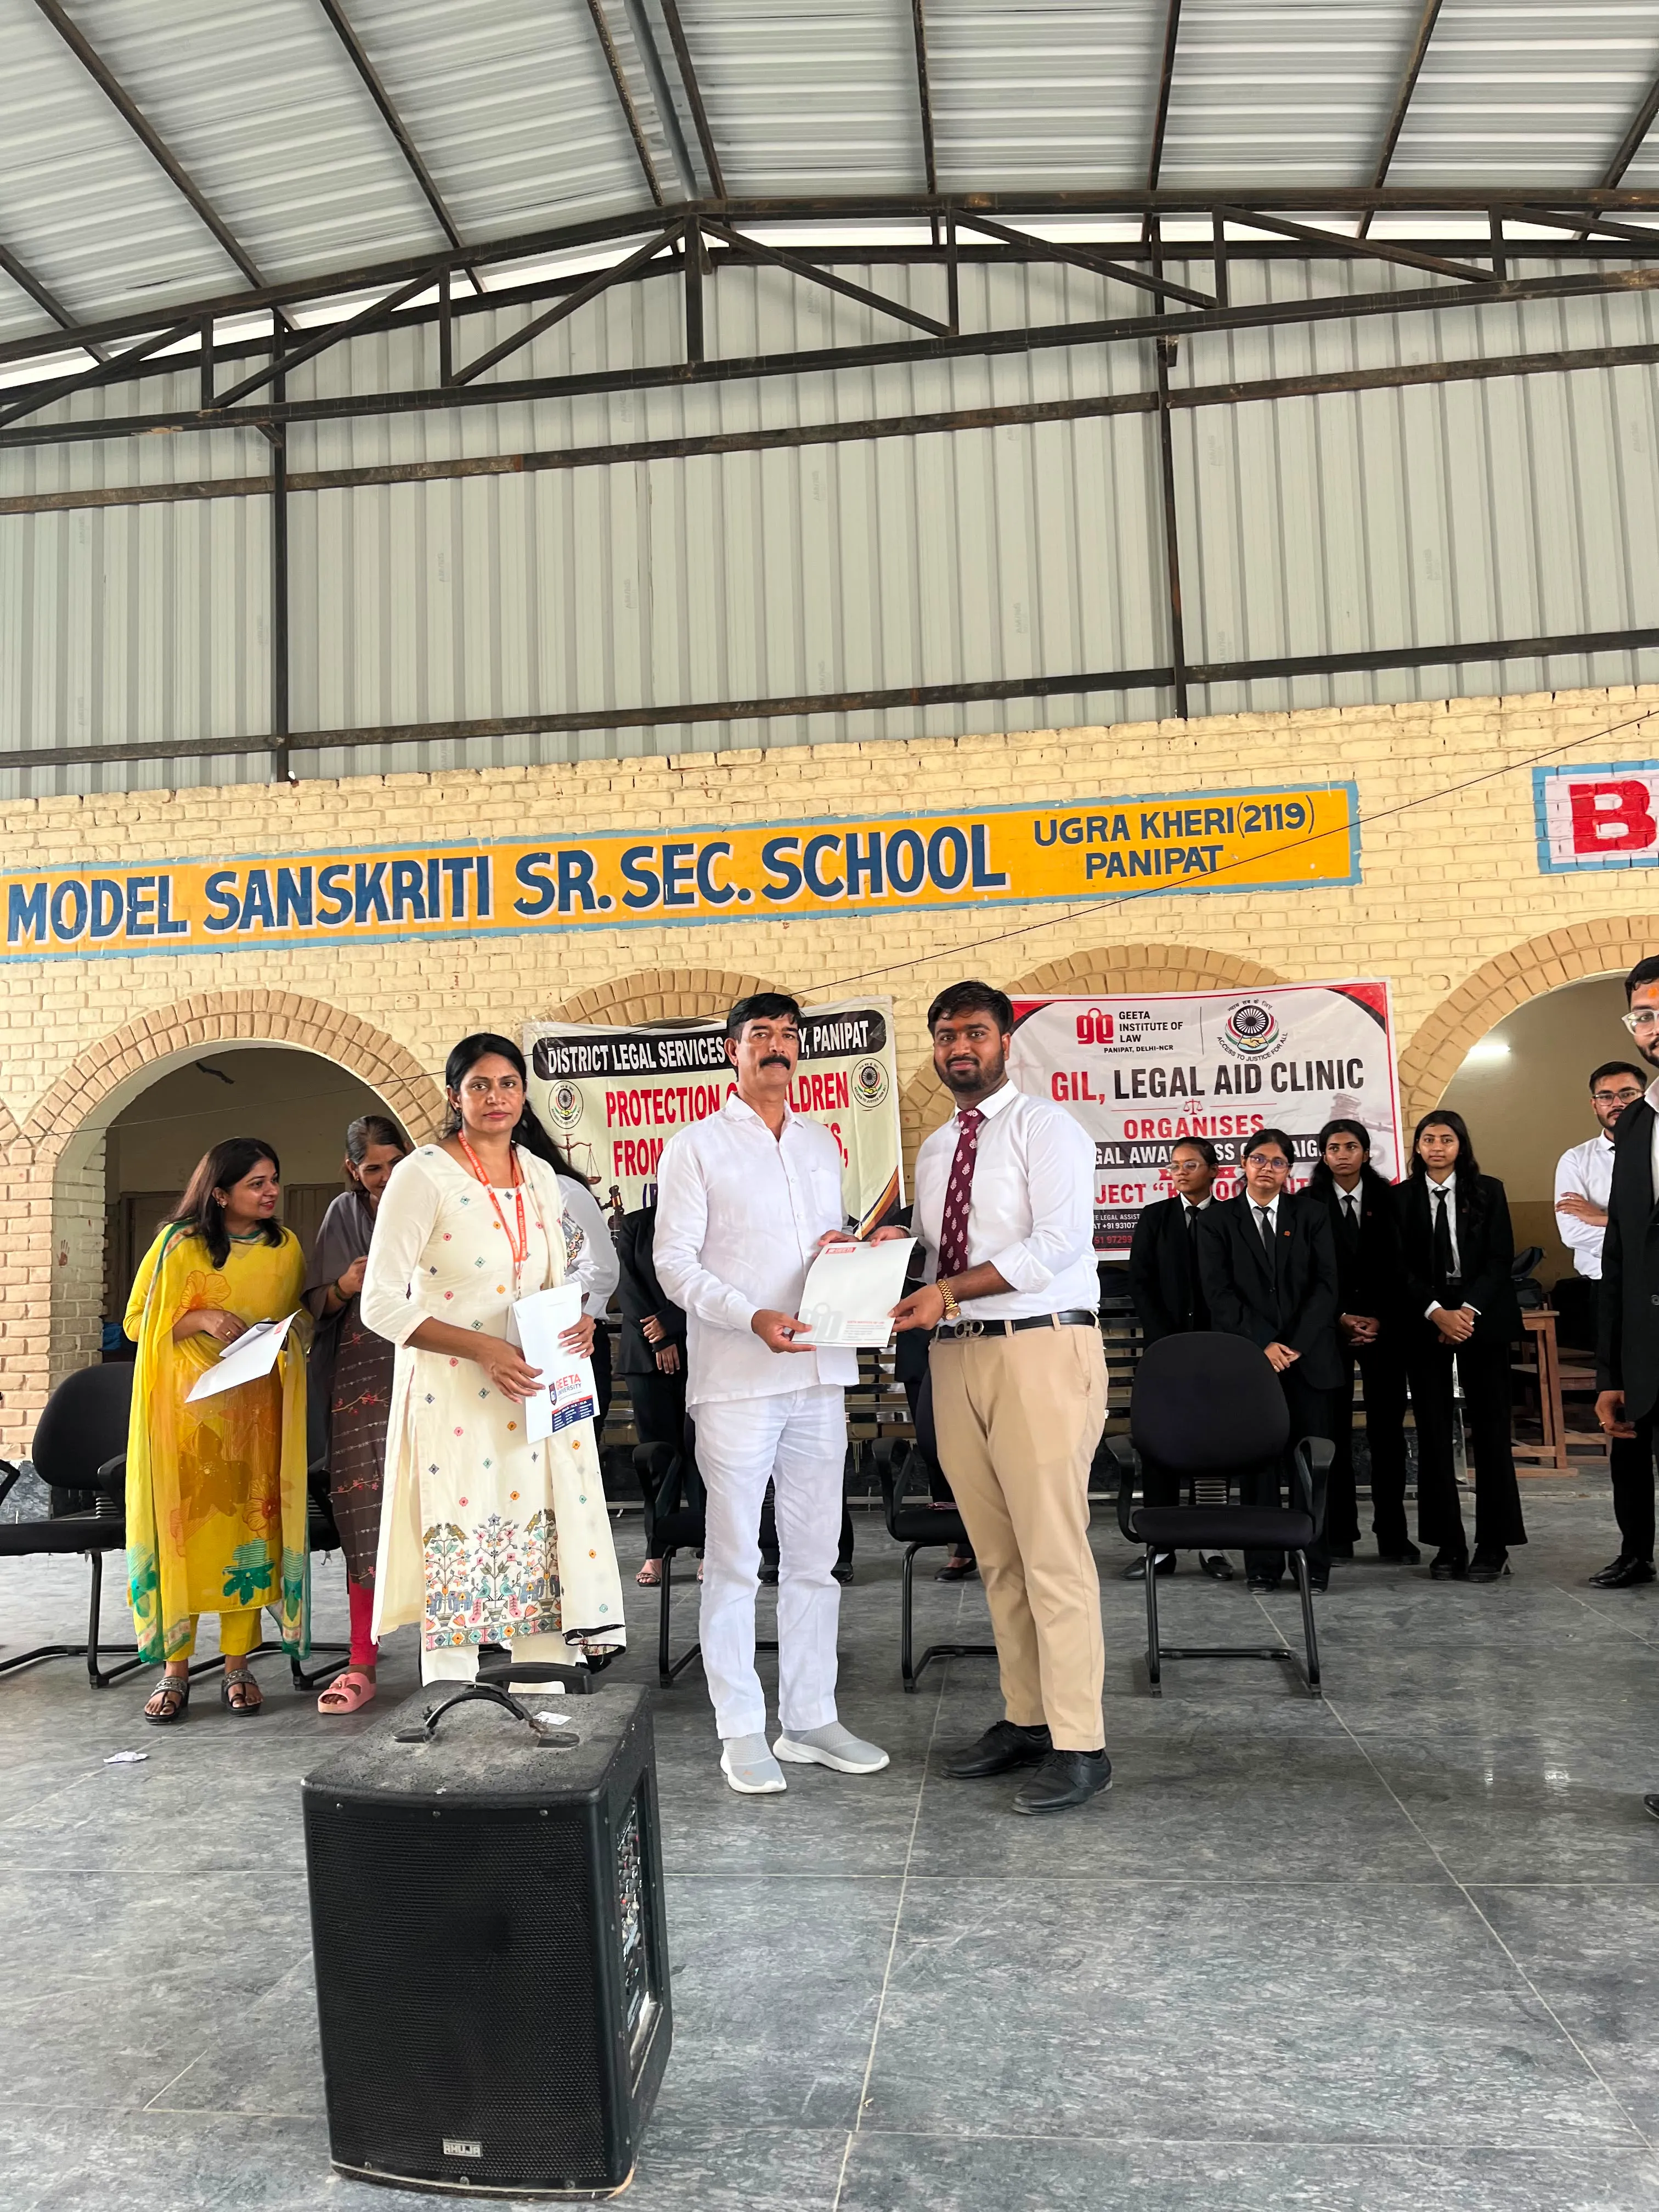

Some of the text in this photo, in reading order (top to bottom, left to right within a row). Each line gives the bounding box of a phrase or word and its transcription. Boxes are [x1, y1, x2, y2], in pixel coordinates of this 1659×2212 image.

[1034, 813, 1131, 847] UGRA
[1085, 844, 1224, 879] PANIPAT
[7, 875, 189, 944] MODEL
[203, 856, 492, 932] SANSKRITI
[1119, 1011, 1150, 1020] GEETA
[1119, 1022, 1183, 1032] INSTITUTE OF
[814, 1020, 868, 1052] PANIPAT
[1120, 1035, 1142, 1043] LAW
[1217, 1036, 1236, 1057] ACCESS
[1246, 1052, 1272, 1062] JUSTICE
[1271, 1043, 1283, 1054] FOR
[1280, 1032, 1288, 1045] ALL
[548, 1036, 726, 1074] DISTRICT LEGAL SERVICES
[786, 1071, 849, 1113] LDREN
[1051, 1058, 1364, 1105] GIL, LEGAL AID CLINIC
[605, 1084, 720, 1128] PROTECTION
[1123, 1114, 1265, 1139] ORGANISES
[613, 1138, 664, 1177] FROM
[1095, 1183, 1147, 1204] JECT
[556, 1374, 582, 1391] GEETA
